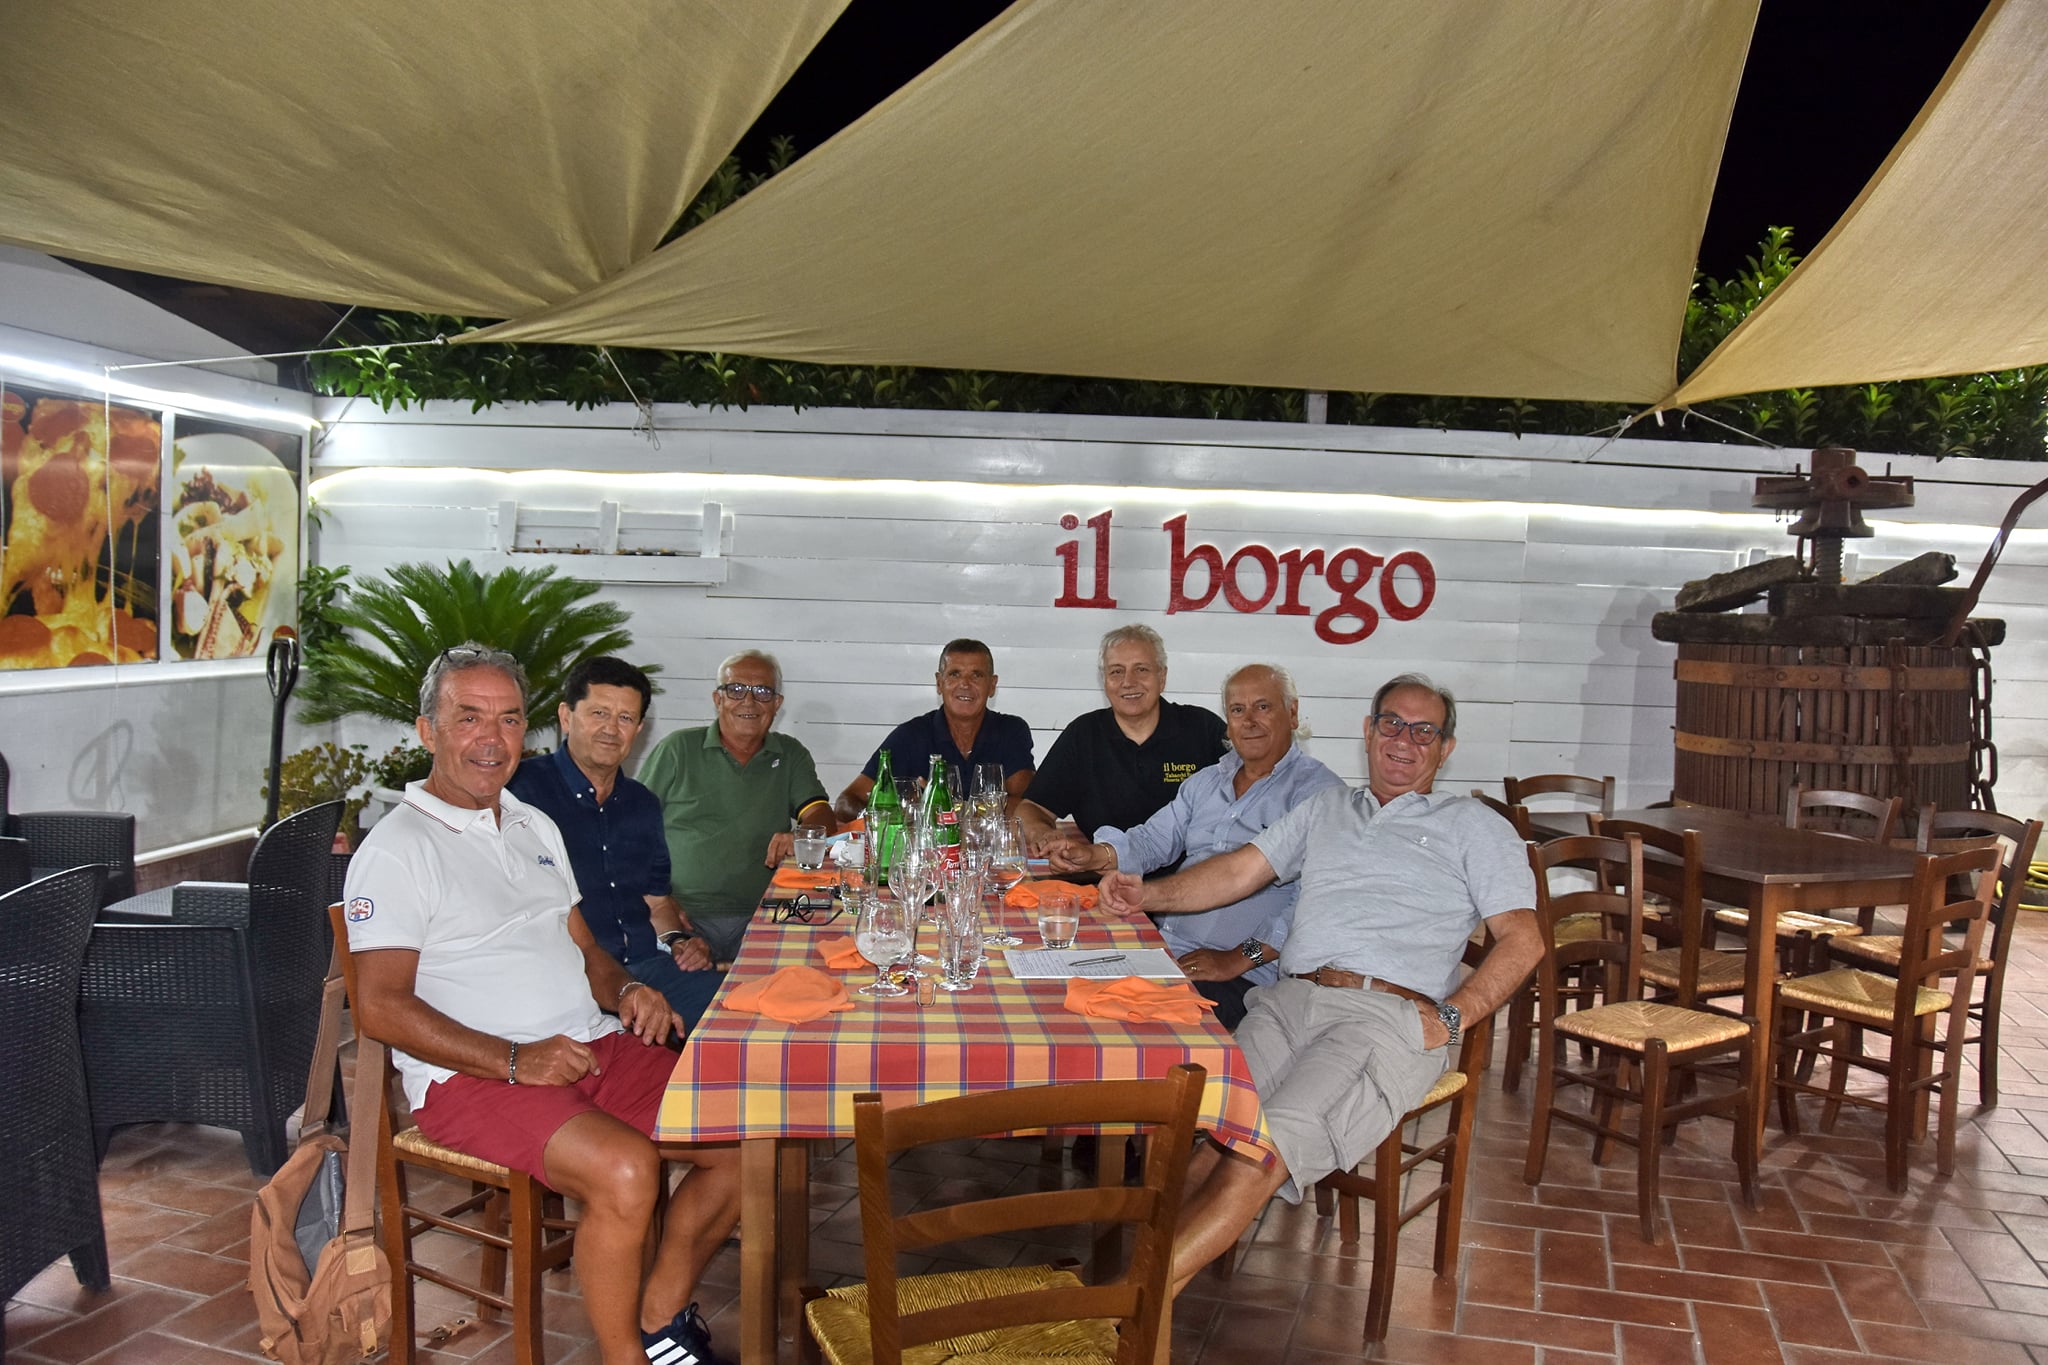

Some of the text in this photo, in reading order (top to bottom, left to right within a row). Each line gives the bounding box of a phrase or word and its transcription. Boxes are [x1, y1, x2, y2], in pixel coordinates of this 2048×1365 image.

[1054, 509, 1436, 645] il borgo
[1164, 762, 1196, 772] il borgo
